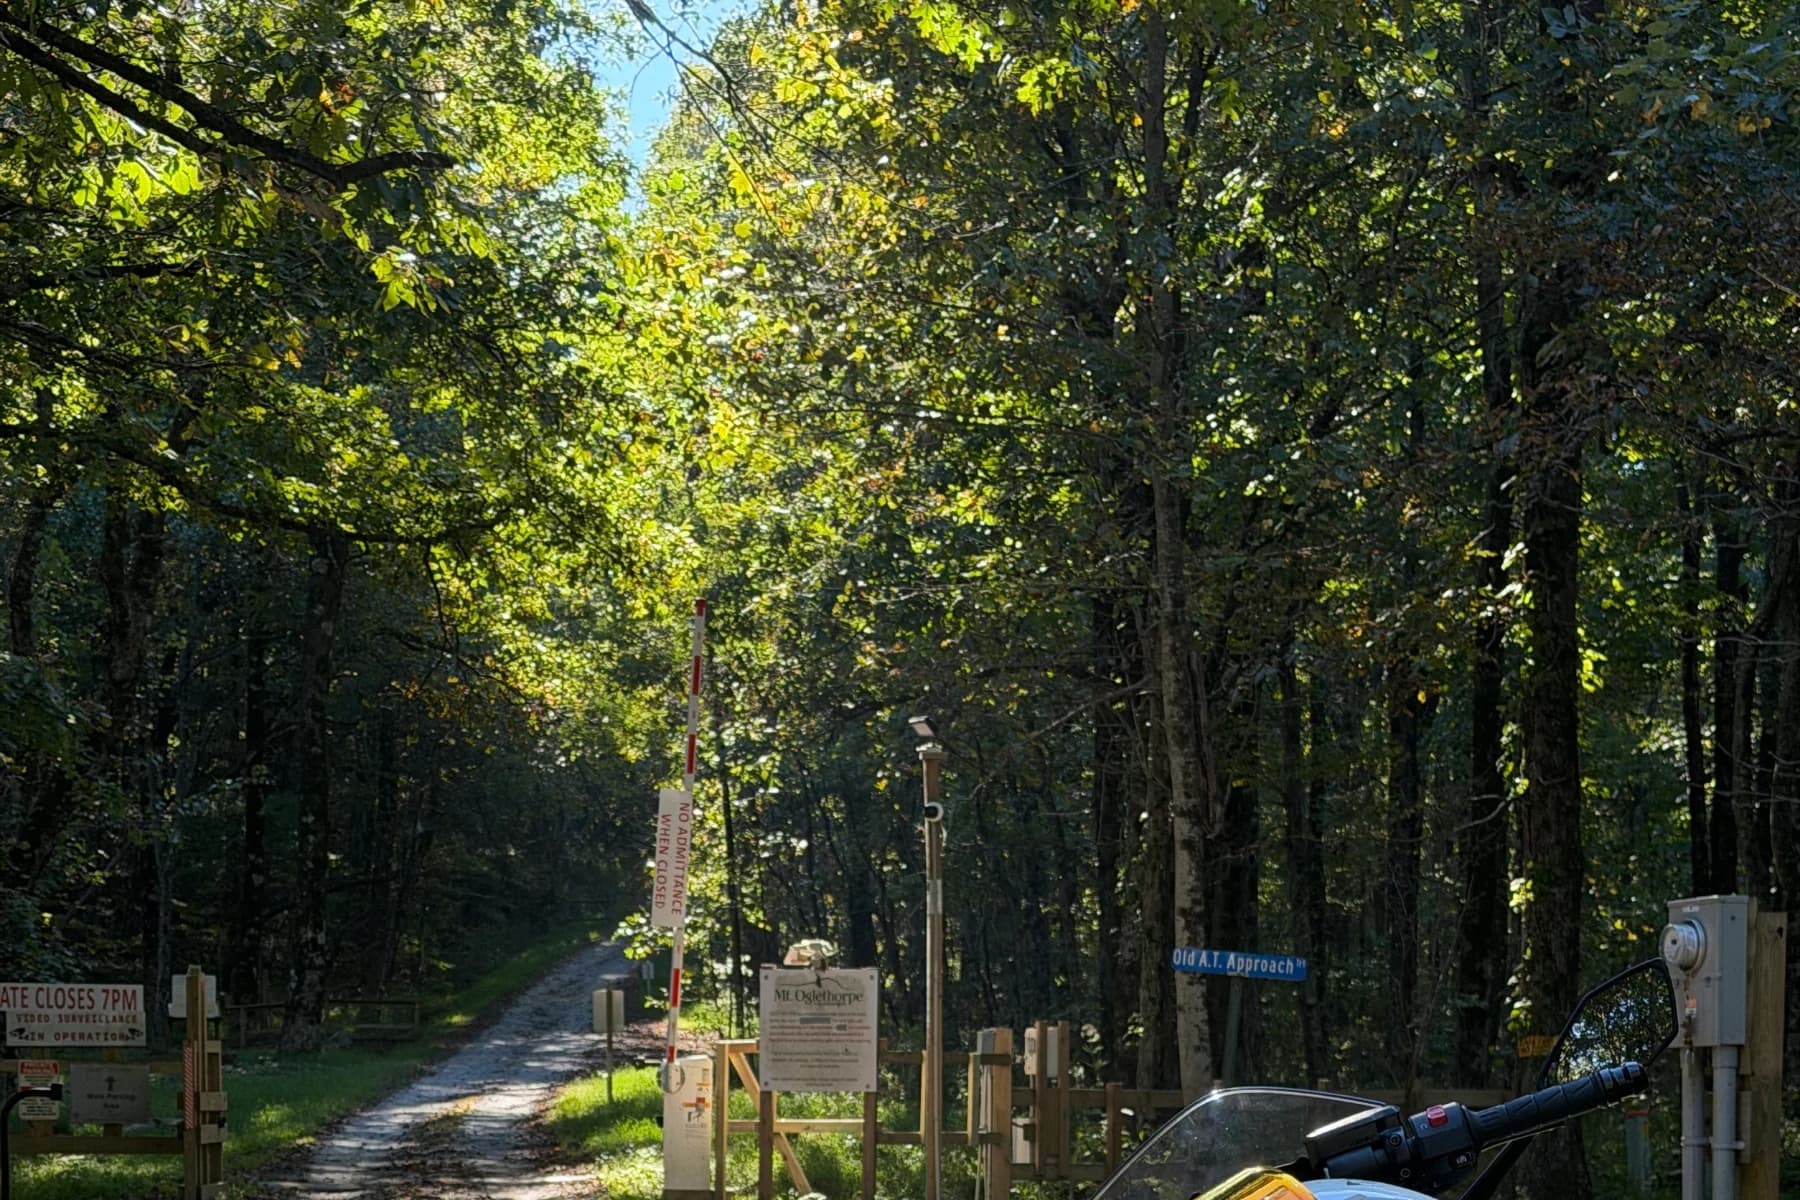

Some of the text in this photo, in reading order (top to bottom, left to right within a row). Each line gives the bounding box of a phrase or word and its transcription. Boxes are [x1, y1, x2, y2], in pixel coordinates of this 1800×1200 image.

[655, 814, 672, 909] WHEN CLOSED
[671, 802, 690, 915] NO ADMITTANCE
[1172, 948, 1195, 966] Old
[1199, 951, 1222, 969] A.T.
[1226, 952, 1294, 975] Approach
[0, 986, 137, 1011] ATE CLOSES 7PM
[795, 989, 863, 1005] Oglethorpe
[16, 1013, 138, 1024] VIDEO SURVEILLANCE
[30, 1031, 126, 1041] IN OPERATION
